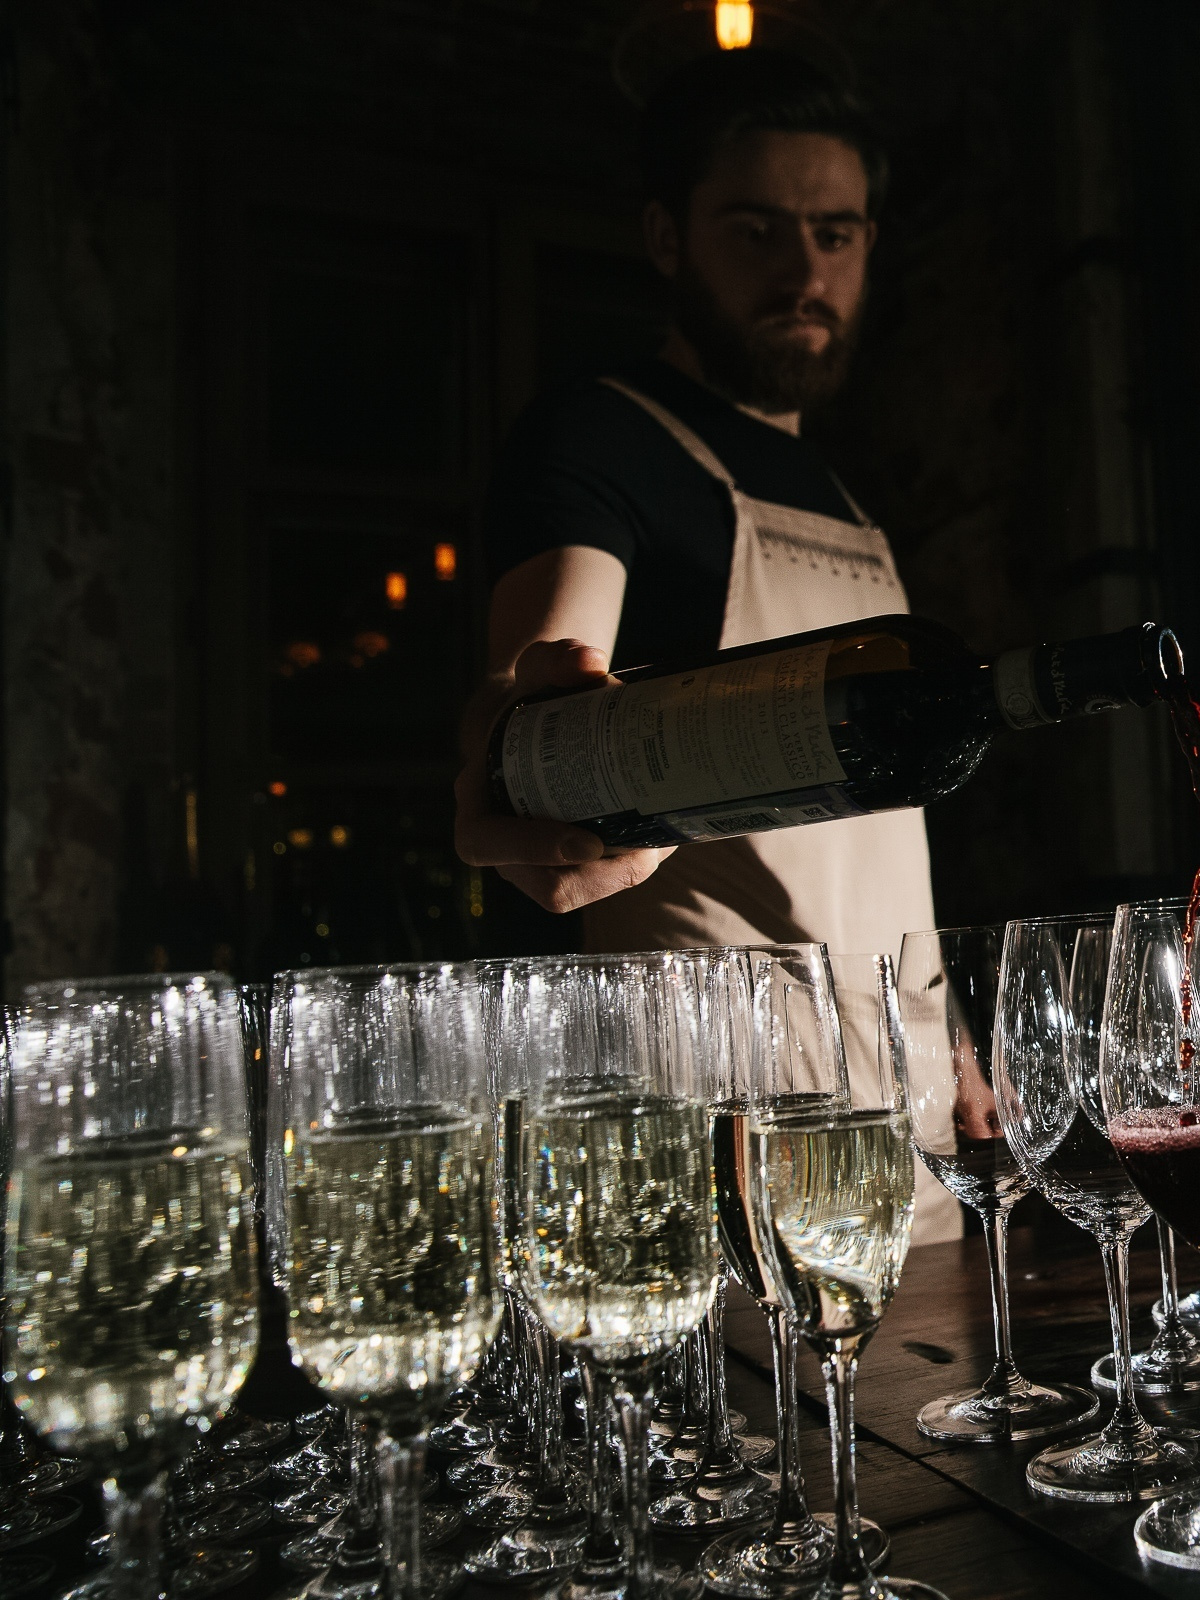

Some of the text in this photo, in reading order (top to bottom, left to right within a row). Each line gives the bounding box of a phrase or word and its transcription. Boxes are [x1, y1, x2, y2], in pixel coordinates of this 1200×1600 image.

[788, 668, 797, 702] PORTA
[757, 702, 768, 734] 2013
[777, 655, 805, 779] CHIANTI CLASSICO
[789, 711, 796, 723] DI
[657, 729, 669, 769] BIOLOGICO
[793, 733, 813, 777] VERTINE
